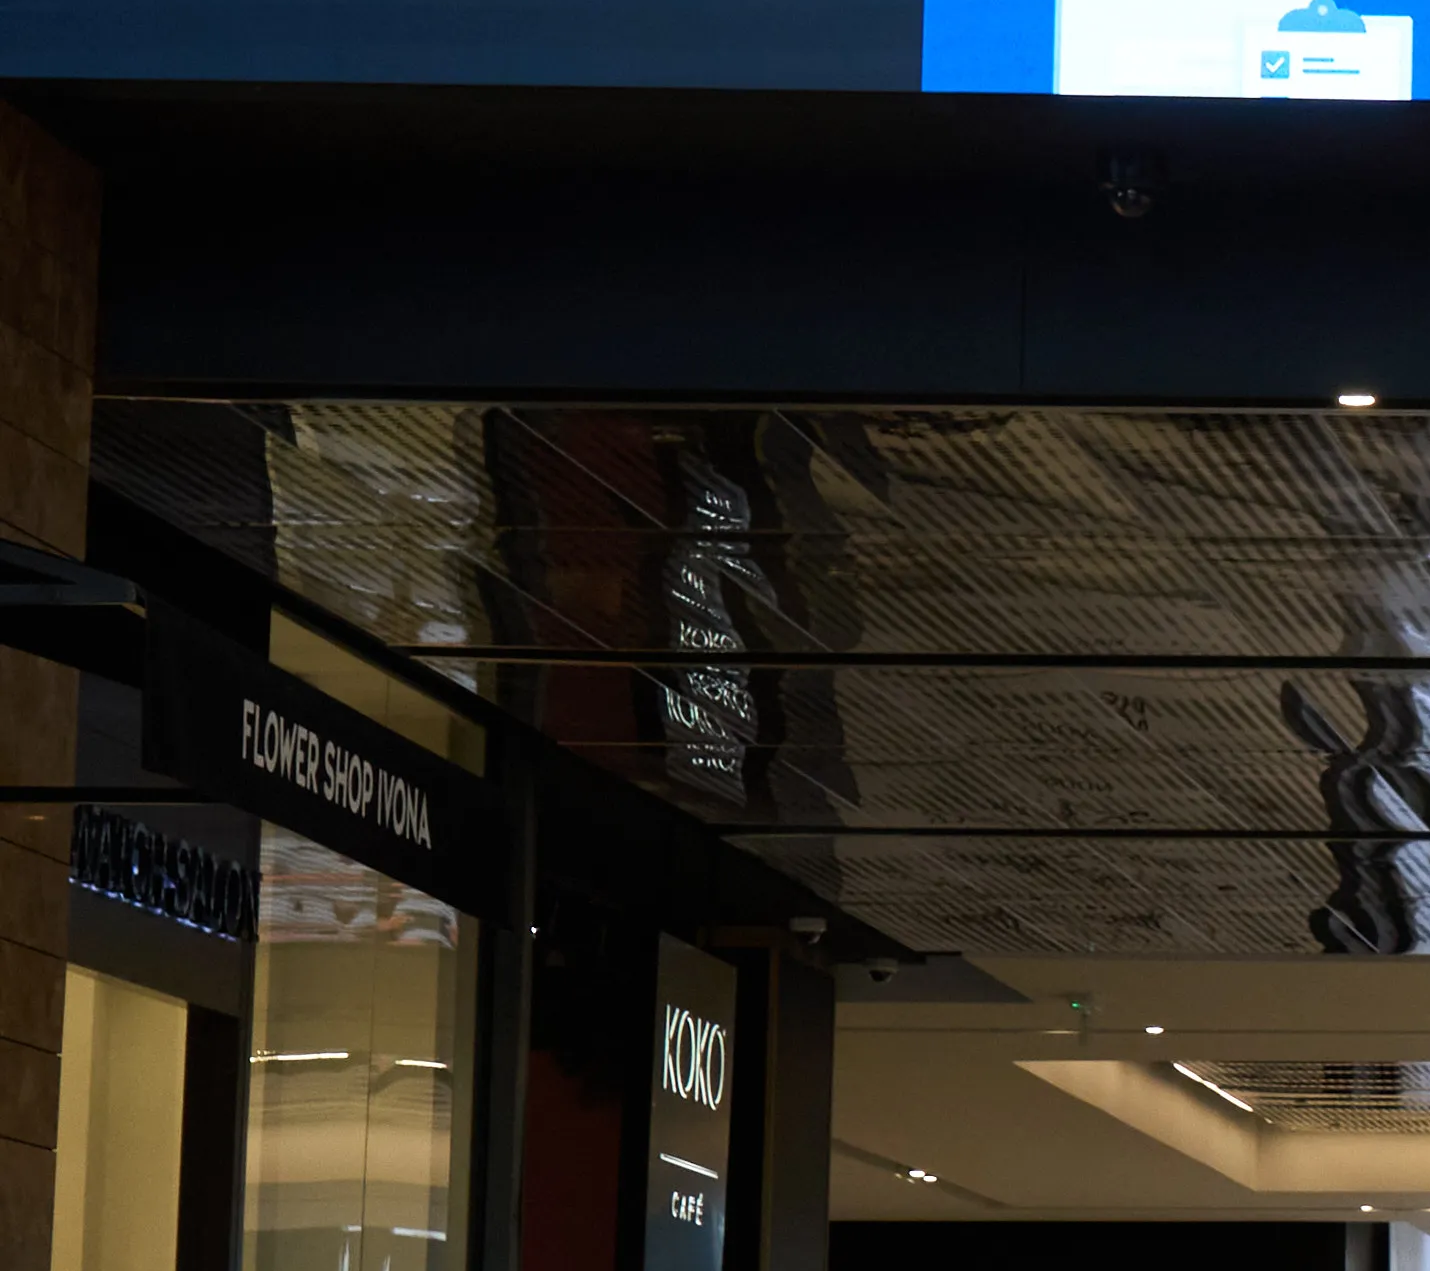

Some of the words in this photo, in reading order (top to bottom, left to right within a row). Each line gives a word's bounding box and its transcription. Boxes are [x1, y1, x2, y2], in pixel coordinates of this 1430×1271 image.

[240, 697, 320, 790] FLOWER
[322, 741, 374, 820] SHOP
[376, 770, 432, 851] IVONA
[662, 1004, 727, 1111] KOKO
[670, 1190, 705, 1226] CAFÉ
